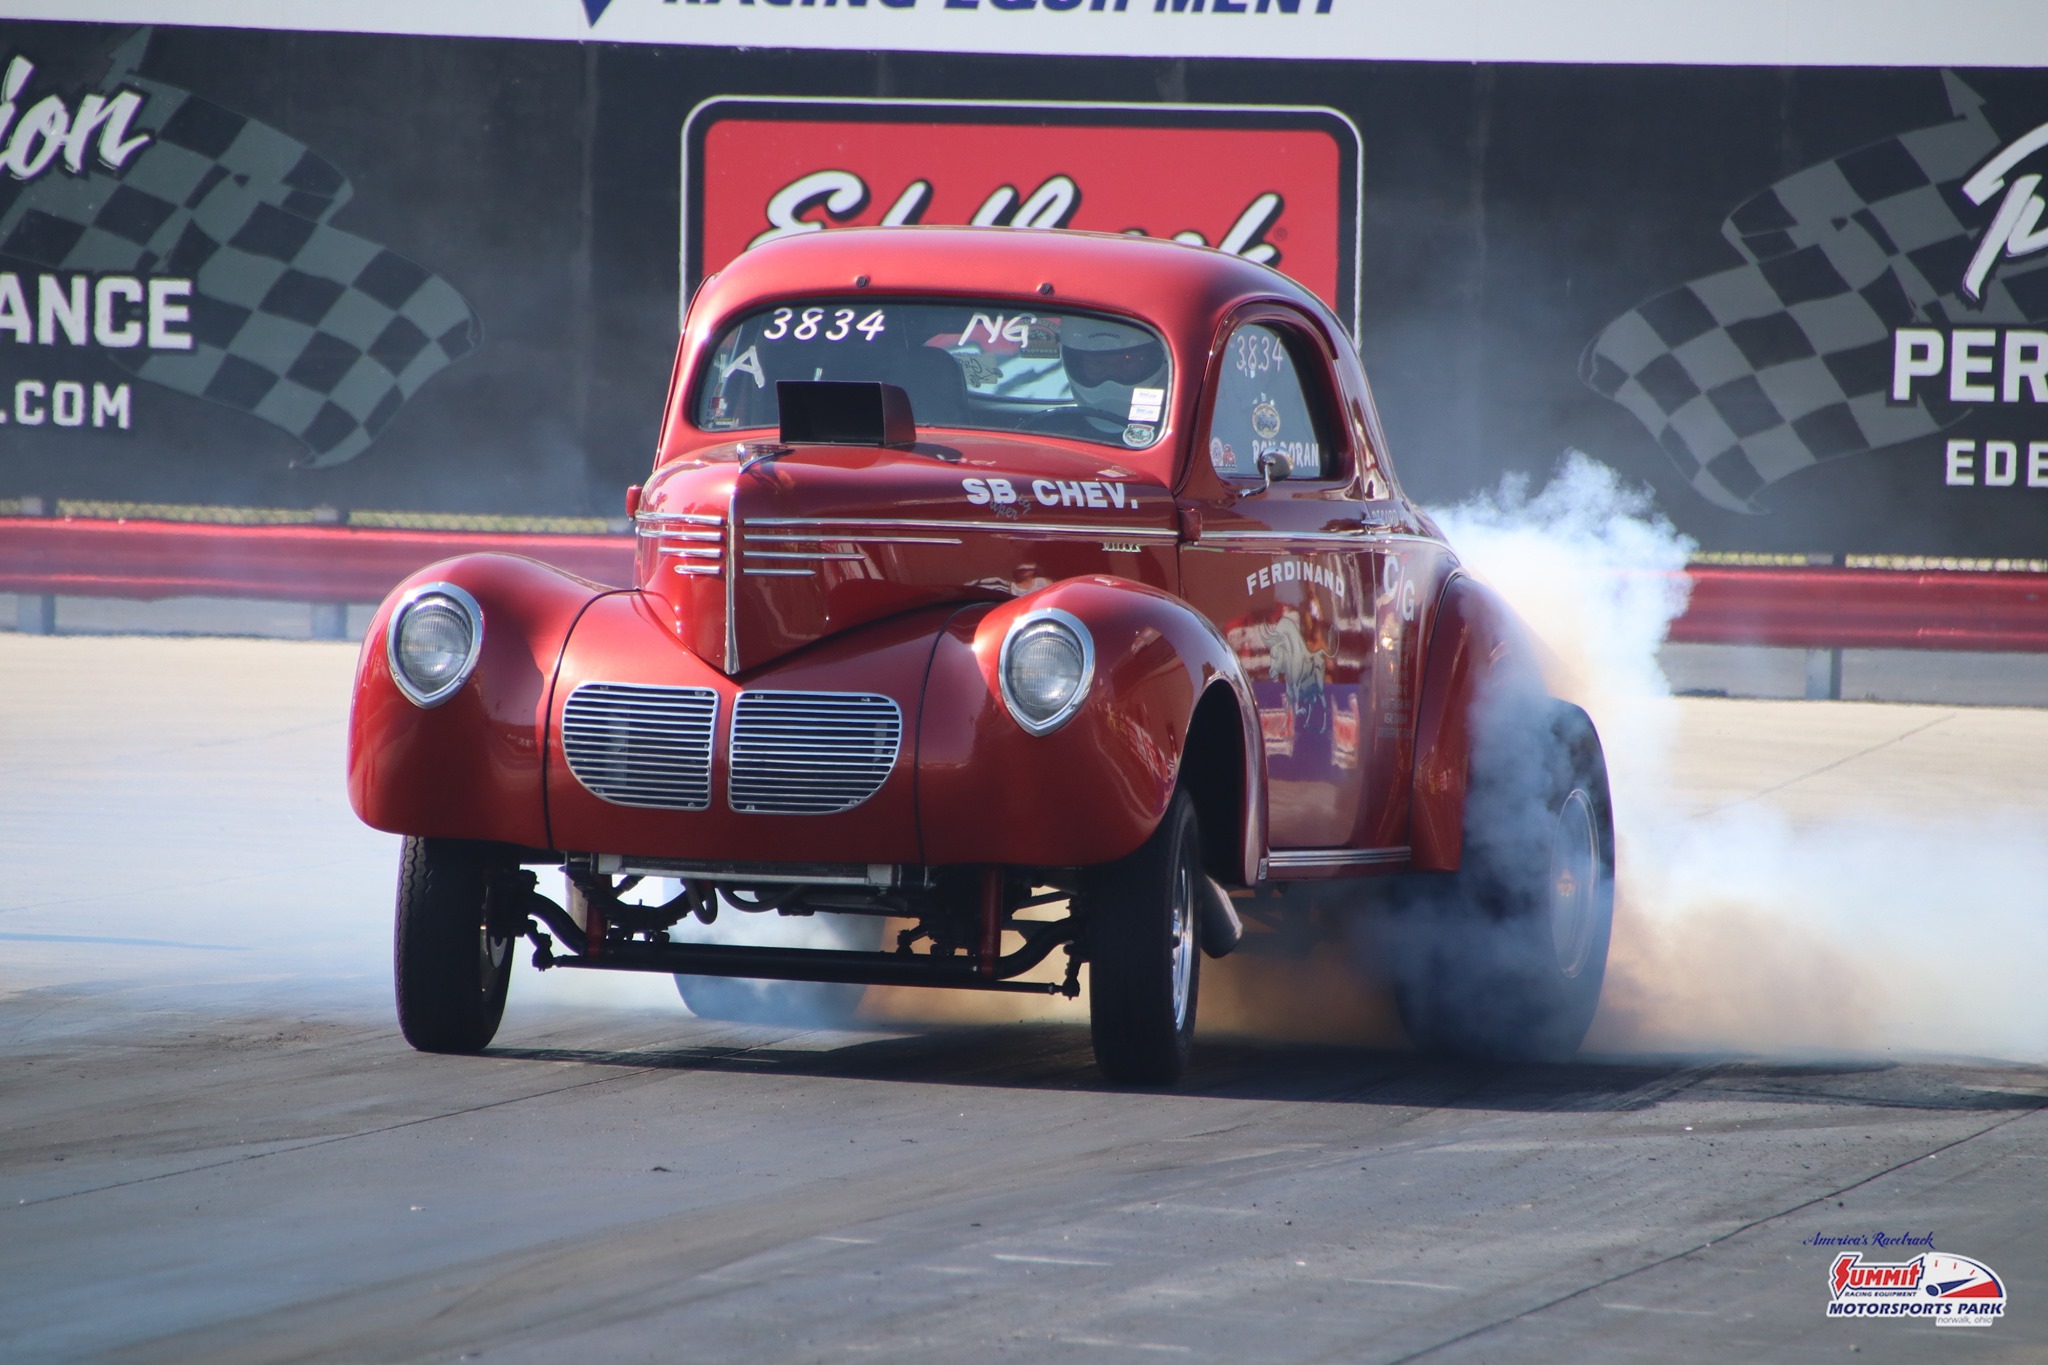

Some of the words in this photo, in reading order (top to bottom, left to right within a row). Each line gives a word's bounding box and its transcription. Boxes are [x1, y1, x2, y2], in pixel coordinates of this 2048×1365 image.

[0, 272, 193, 350] ANCE
[764, 307, 885, 342] 3834
[722, 345, 766, 389] A
[1236, 335, 1284, 372] 3834
[1893, 328, 2048, 403] PER
[961, 478, 1017, 505] SB
[1031, 479, 1139, 510] CHEV.
[1246, 560, 1346, 597] FERDINAND
